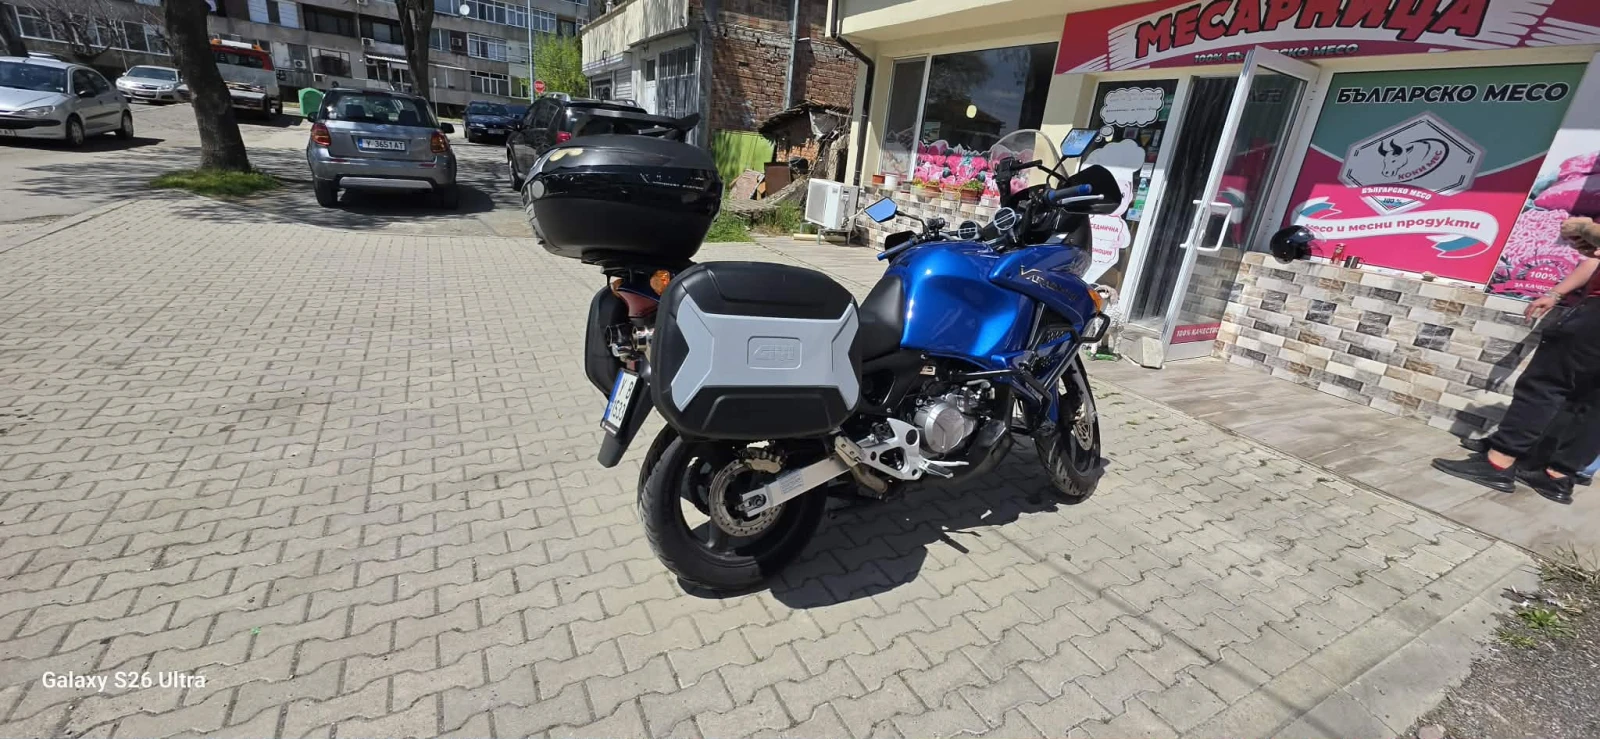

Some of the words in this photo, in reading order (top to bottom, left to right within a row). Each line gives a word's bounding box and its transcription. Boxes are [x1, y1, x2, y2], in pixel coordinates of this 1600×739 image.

[1135, 0, 1489, 58] МЕСАРНИЦА
[1194, 53, 1223, 63] 100%
[1311, 43, 1359, 57] МЕСО
[1336, 85, 1478, 104] БЪЛГАРСКО
[1481, 82, 1570, 103] МЕСО
[1362, 186, 1408, 195] БЪЛГАРСКО
[1410, 189, 1432, 200] МЕСО
[1348, 221, 1393, 232] месни
[1396, 217, 1481, 231] продукти
[1530, 271, 1557, 282] 100%
[1525, 283, 1554, 292] КАЧЕСТ
